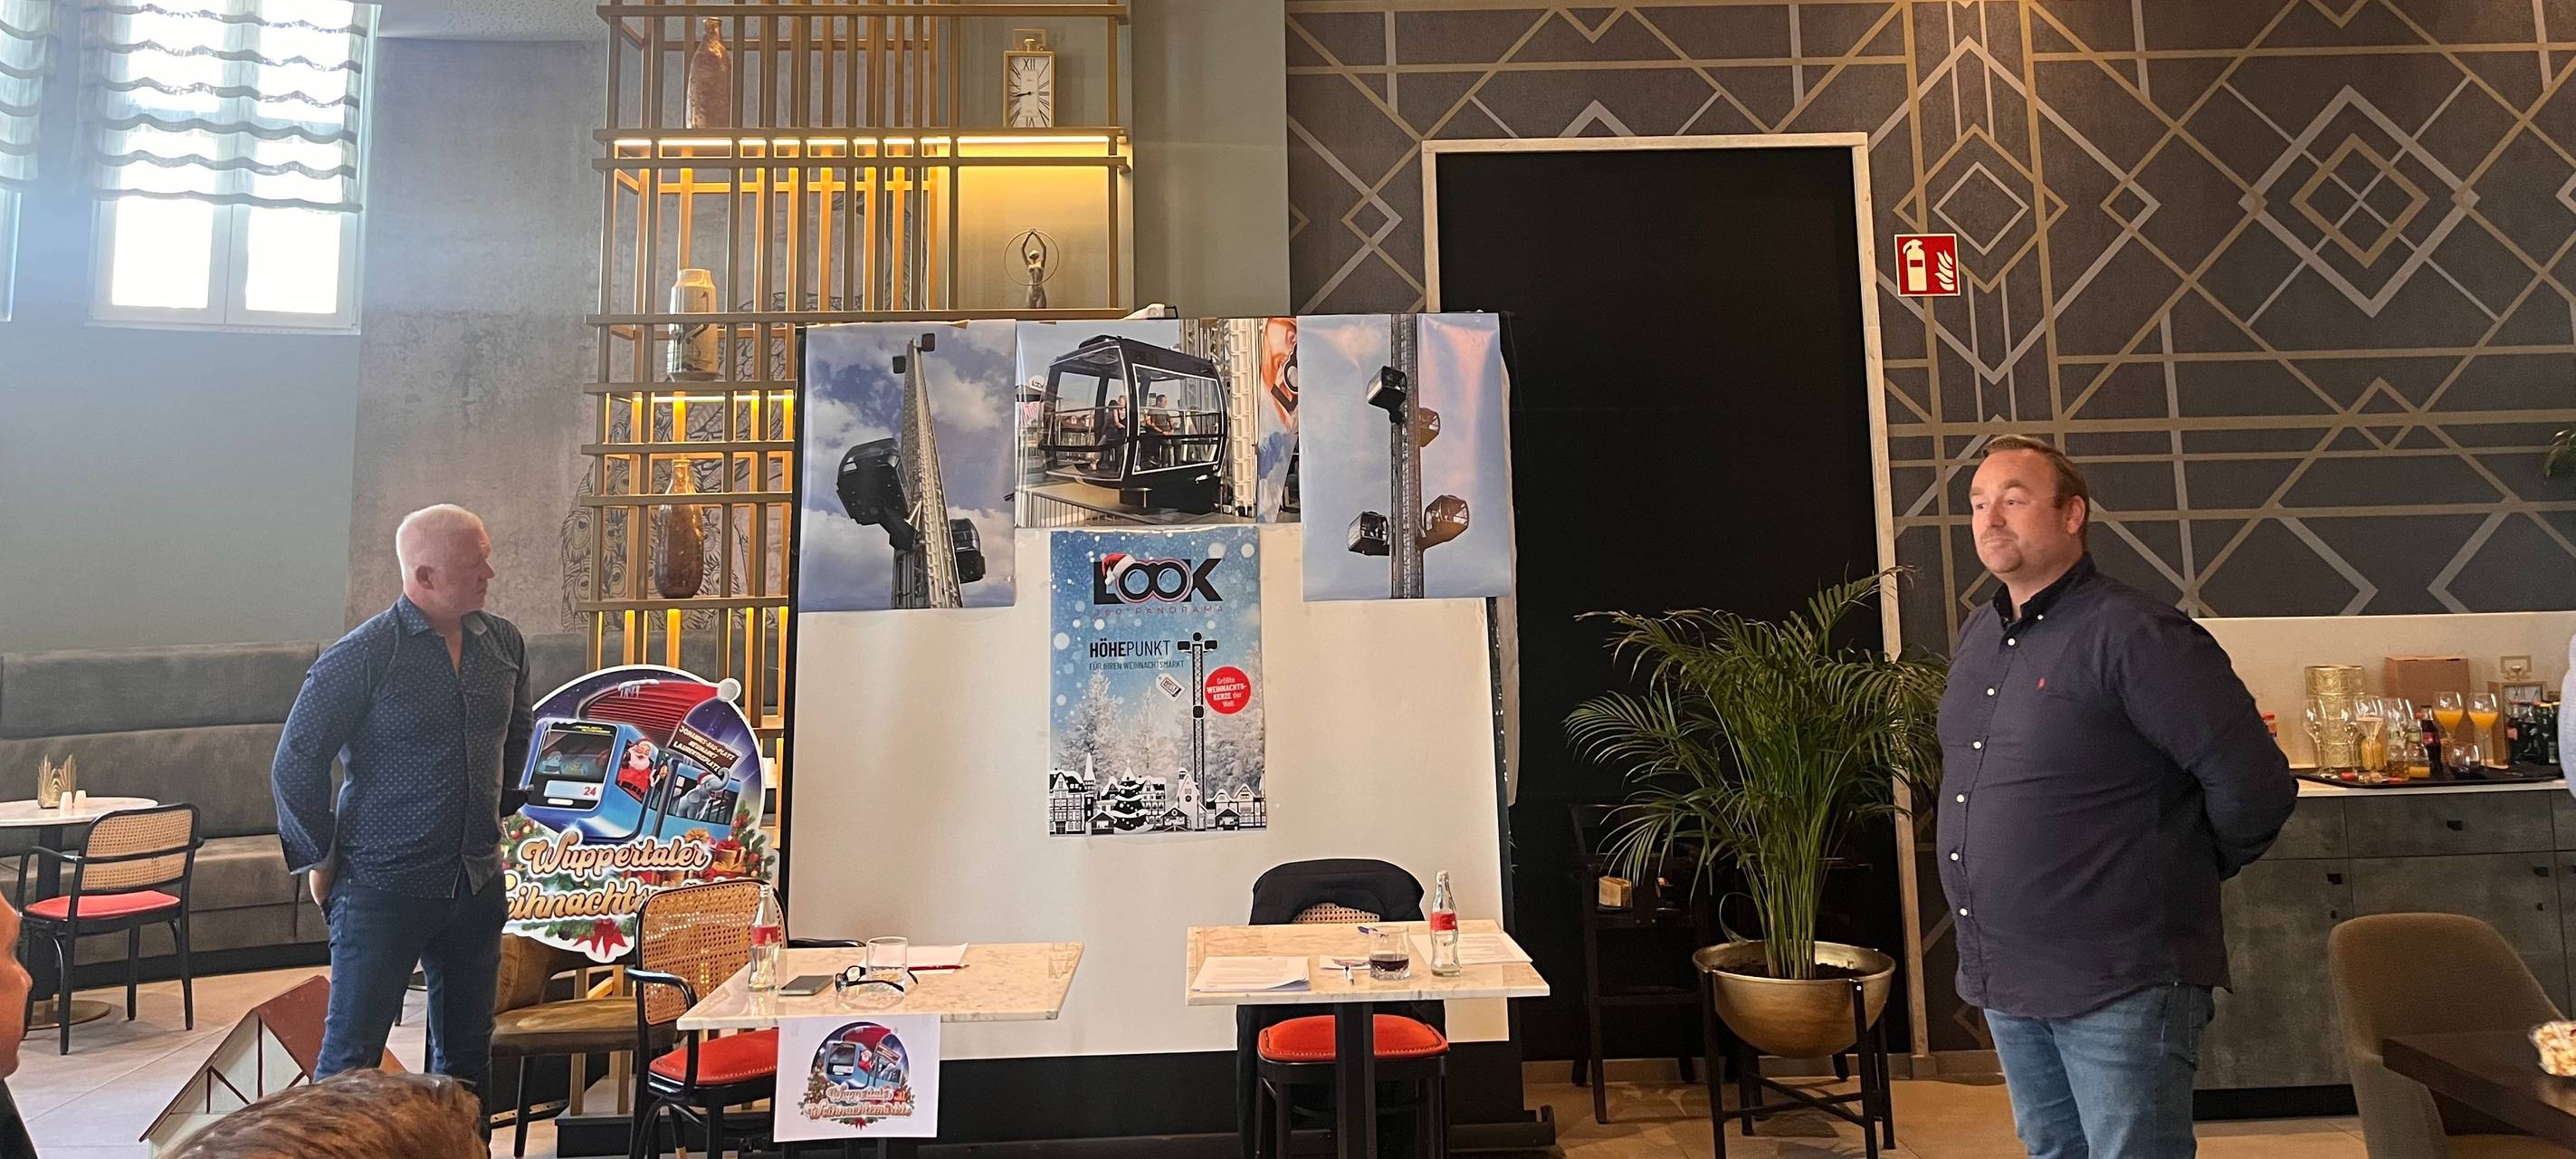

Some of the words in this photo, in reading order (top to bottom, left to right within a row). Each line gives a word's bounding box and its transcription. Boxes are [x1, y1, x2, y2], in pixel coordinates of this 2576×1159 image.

[1023, 58, 1035, 70] XII
[1093, 558, 1224, 605] LOOK
[1135, 606, 1224, 616] PANORAMA
[1090, 637, 1171, 658] HÖHEPUNKT
[1089, 661, 1102, 671] FÜR
[1102, 661, 1122, 670] IHREN
[1123, 660, 1185, 670] WEIHNACHTSMARKT
[1207, 683, 1247, 694] WEIHNACHTS-
[583, 786, 597, 796] 24
[520, 830, 709, 877] Wuppertaler
